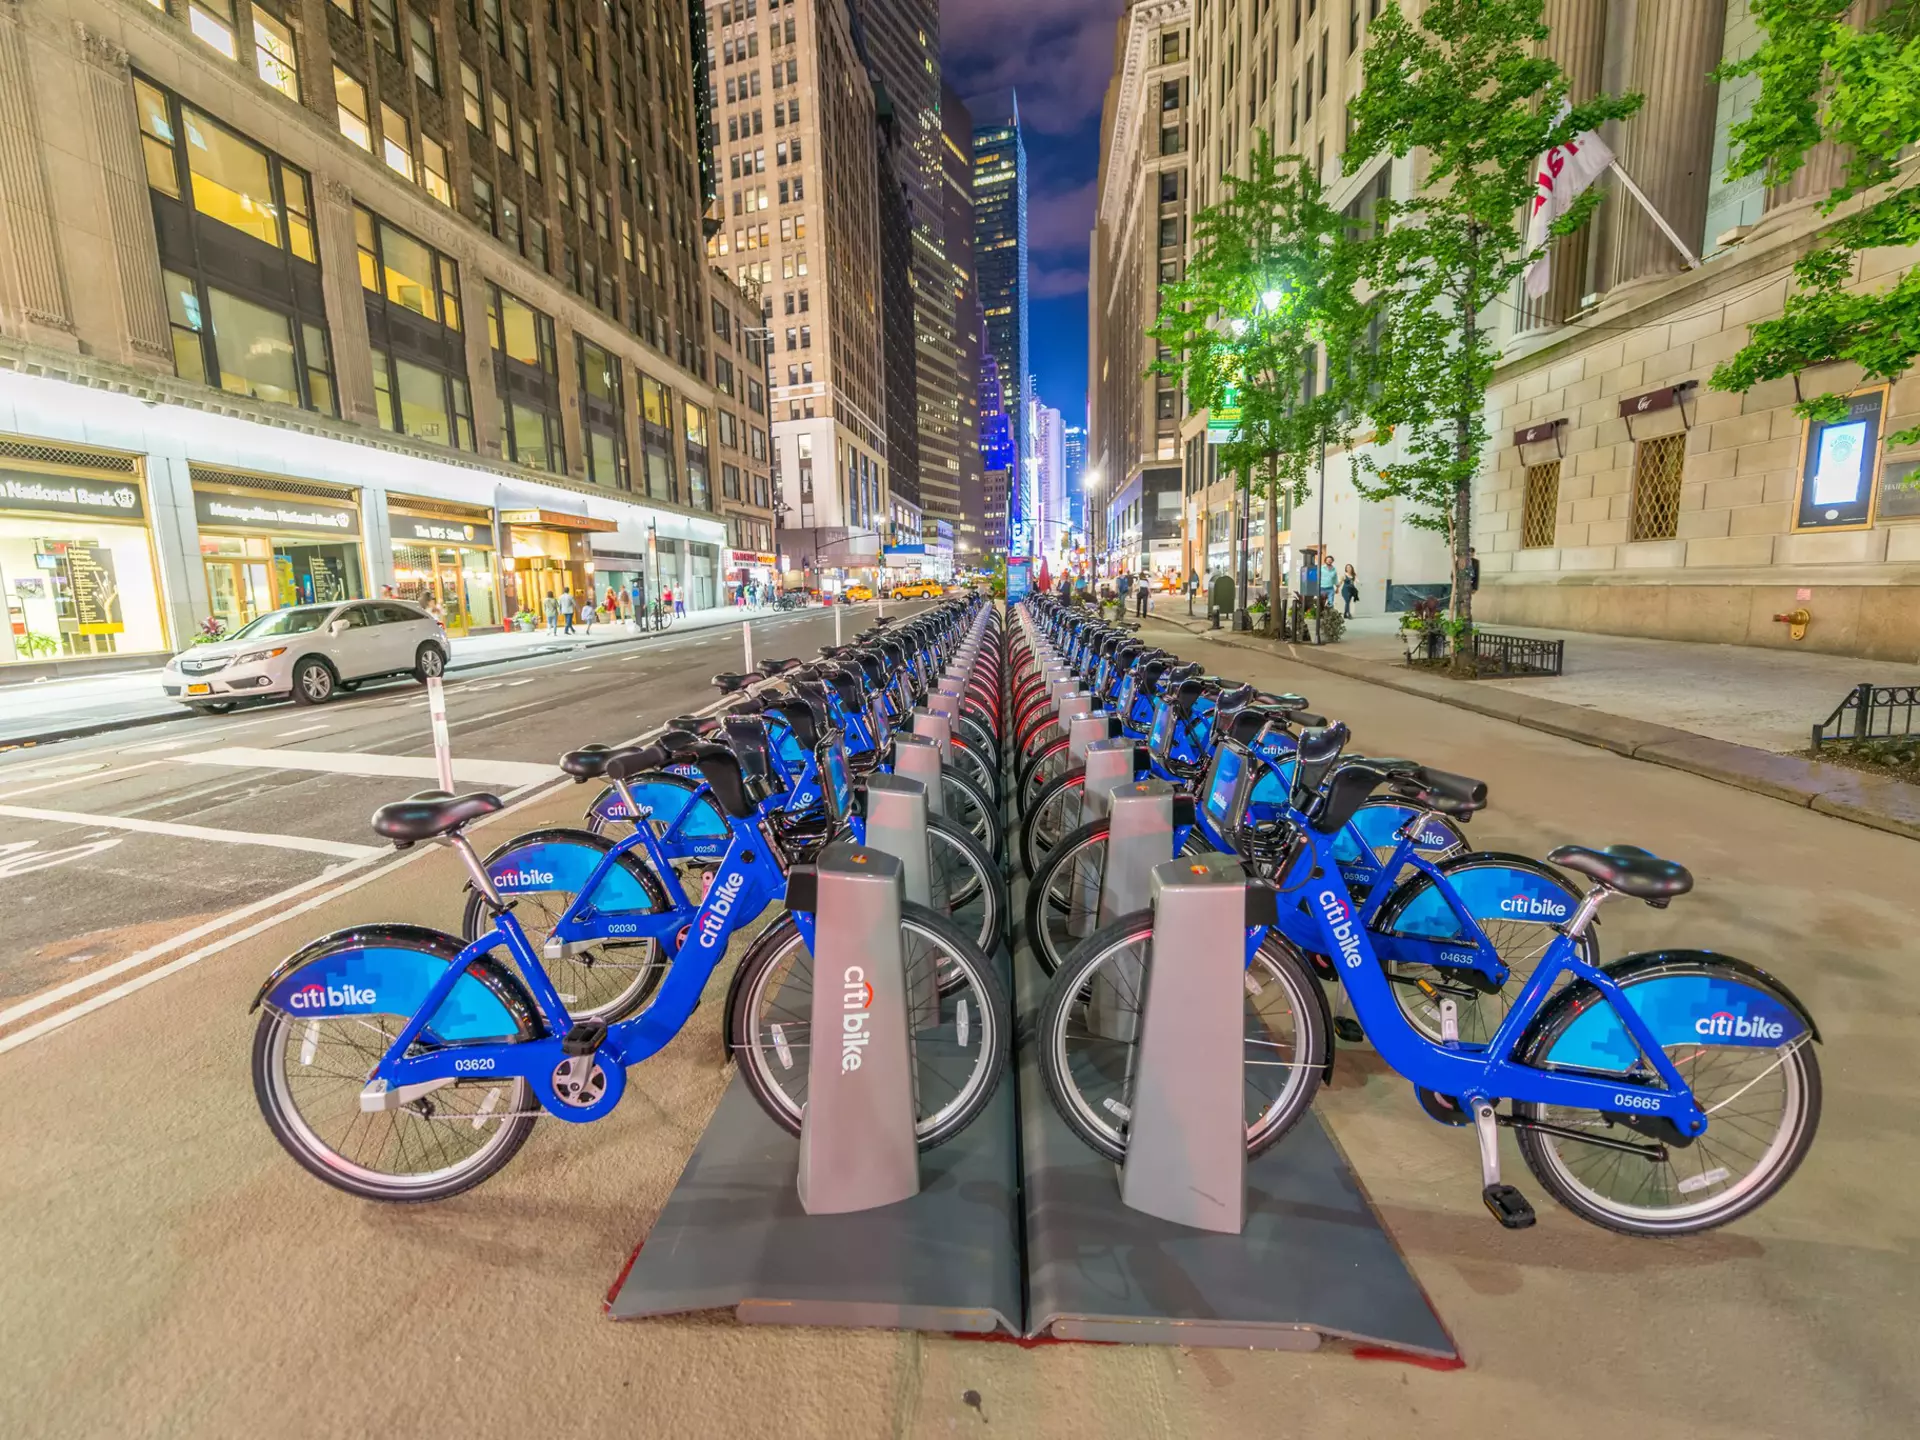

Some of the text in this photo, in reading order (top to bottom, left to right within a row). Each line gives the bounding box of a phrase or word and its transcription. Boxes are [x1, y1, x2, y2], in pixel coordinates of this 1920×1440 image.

[5, 480, 77, 503] National
[77, 488, 117, 506] Bank
[608, 923, 637, 934] 02030
[1440, 951, 1474, 965] 04635
[455, 1057, 496, 1072] 03620
[1614, 1093, 1661, 1112] 05665
